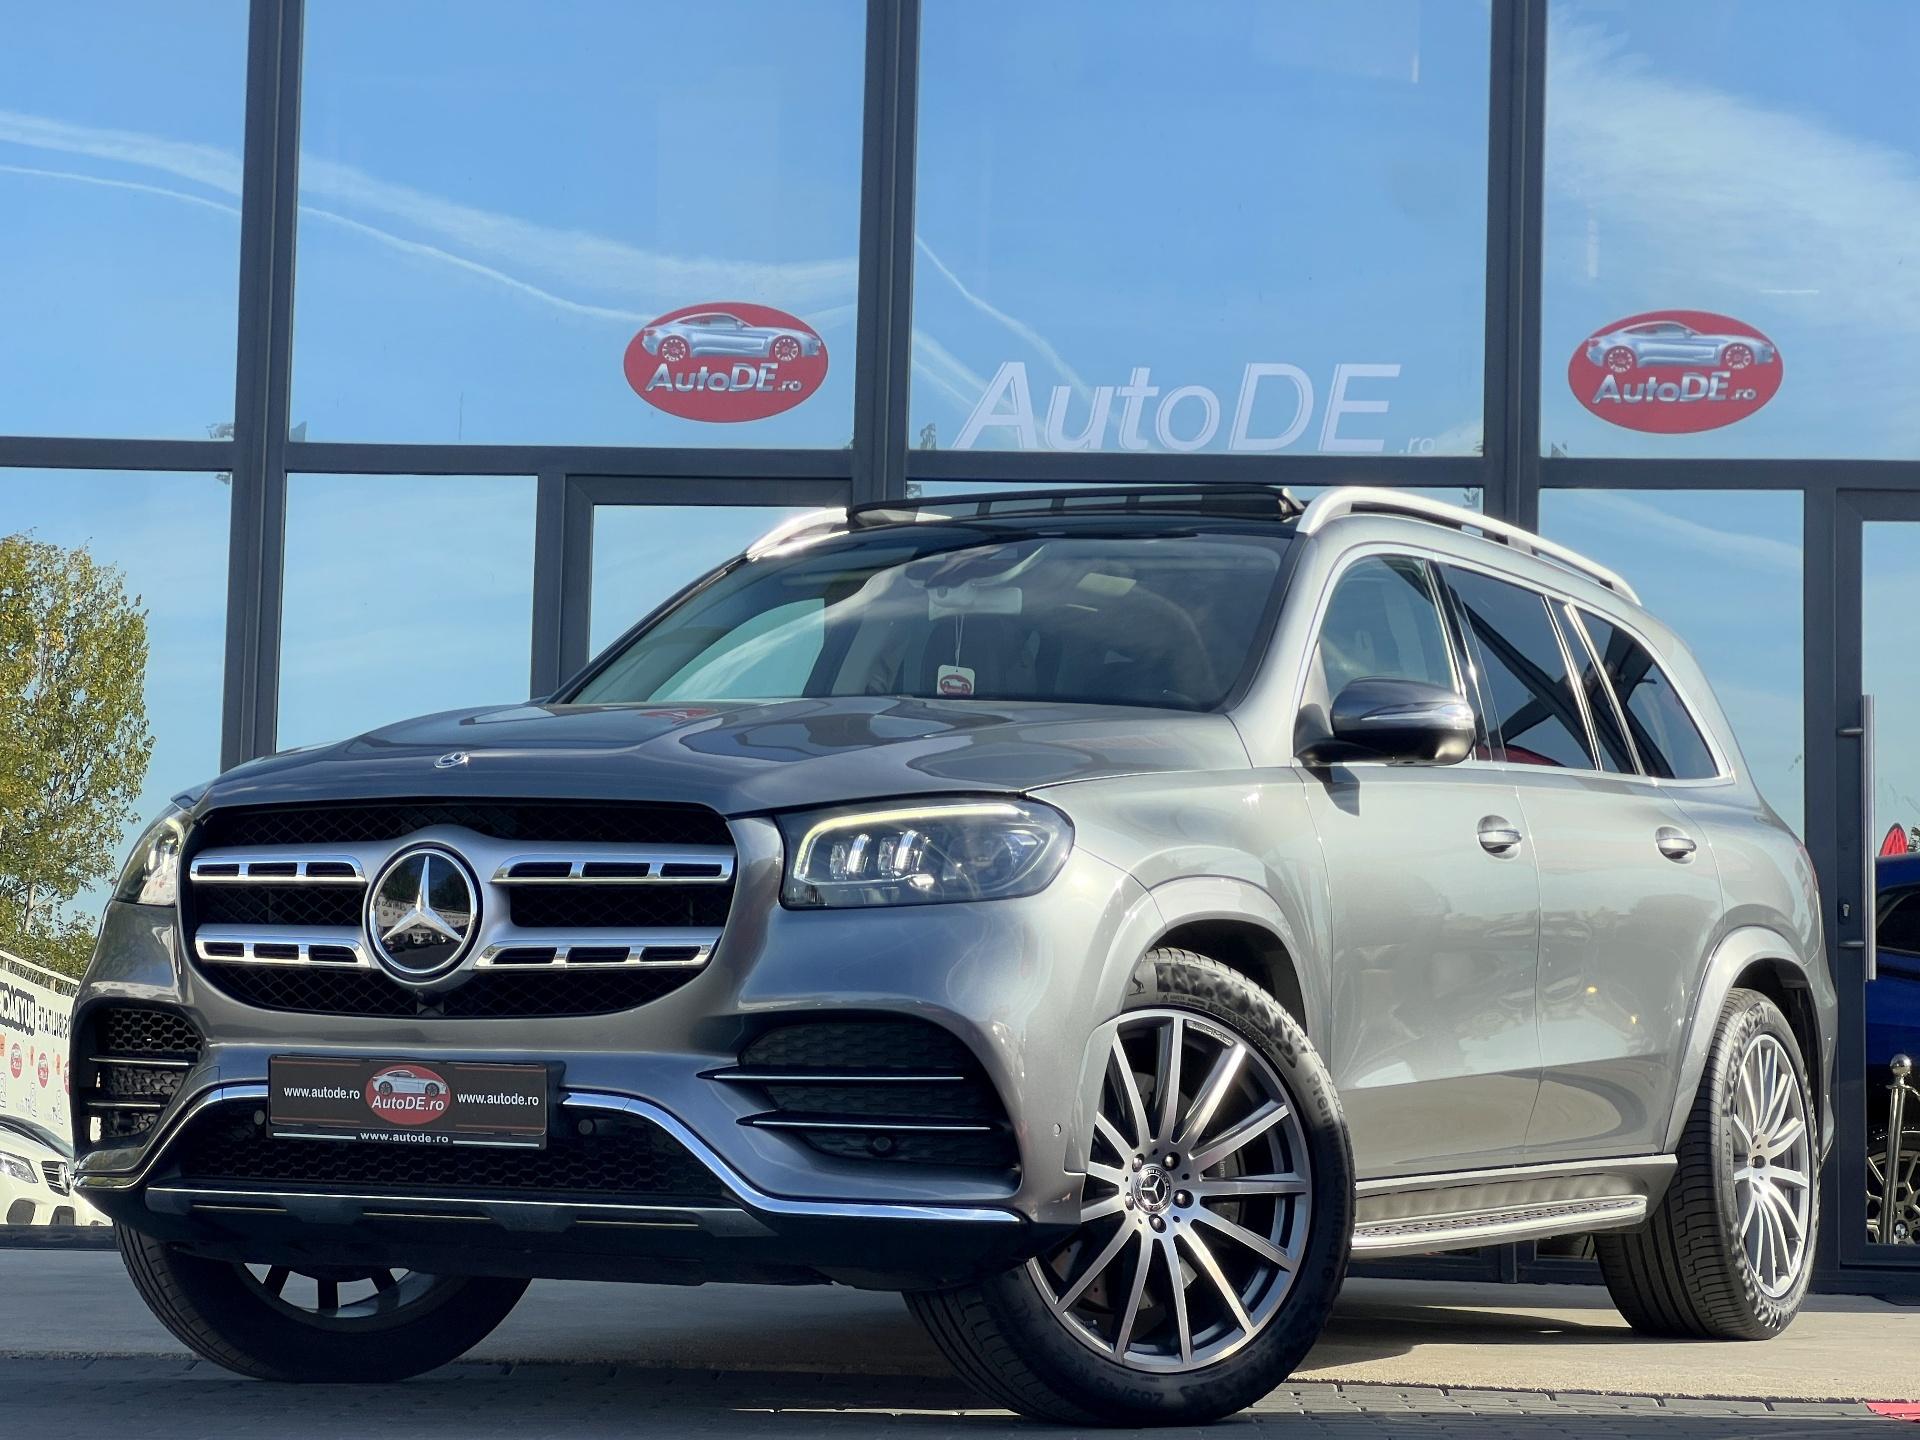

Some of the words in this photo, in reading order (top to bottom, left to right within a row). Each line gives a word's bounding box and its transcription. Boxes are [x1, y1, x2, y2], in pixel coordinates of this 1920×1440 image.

[283, 1085, 361, 1100] www.autode.ro
[457, 1092, 539, 1106] www.autode.ro
[371, 1095, 445, 1111] AutoDE.ro
[360, 1131, 449, 1143] www.autode.ro
